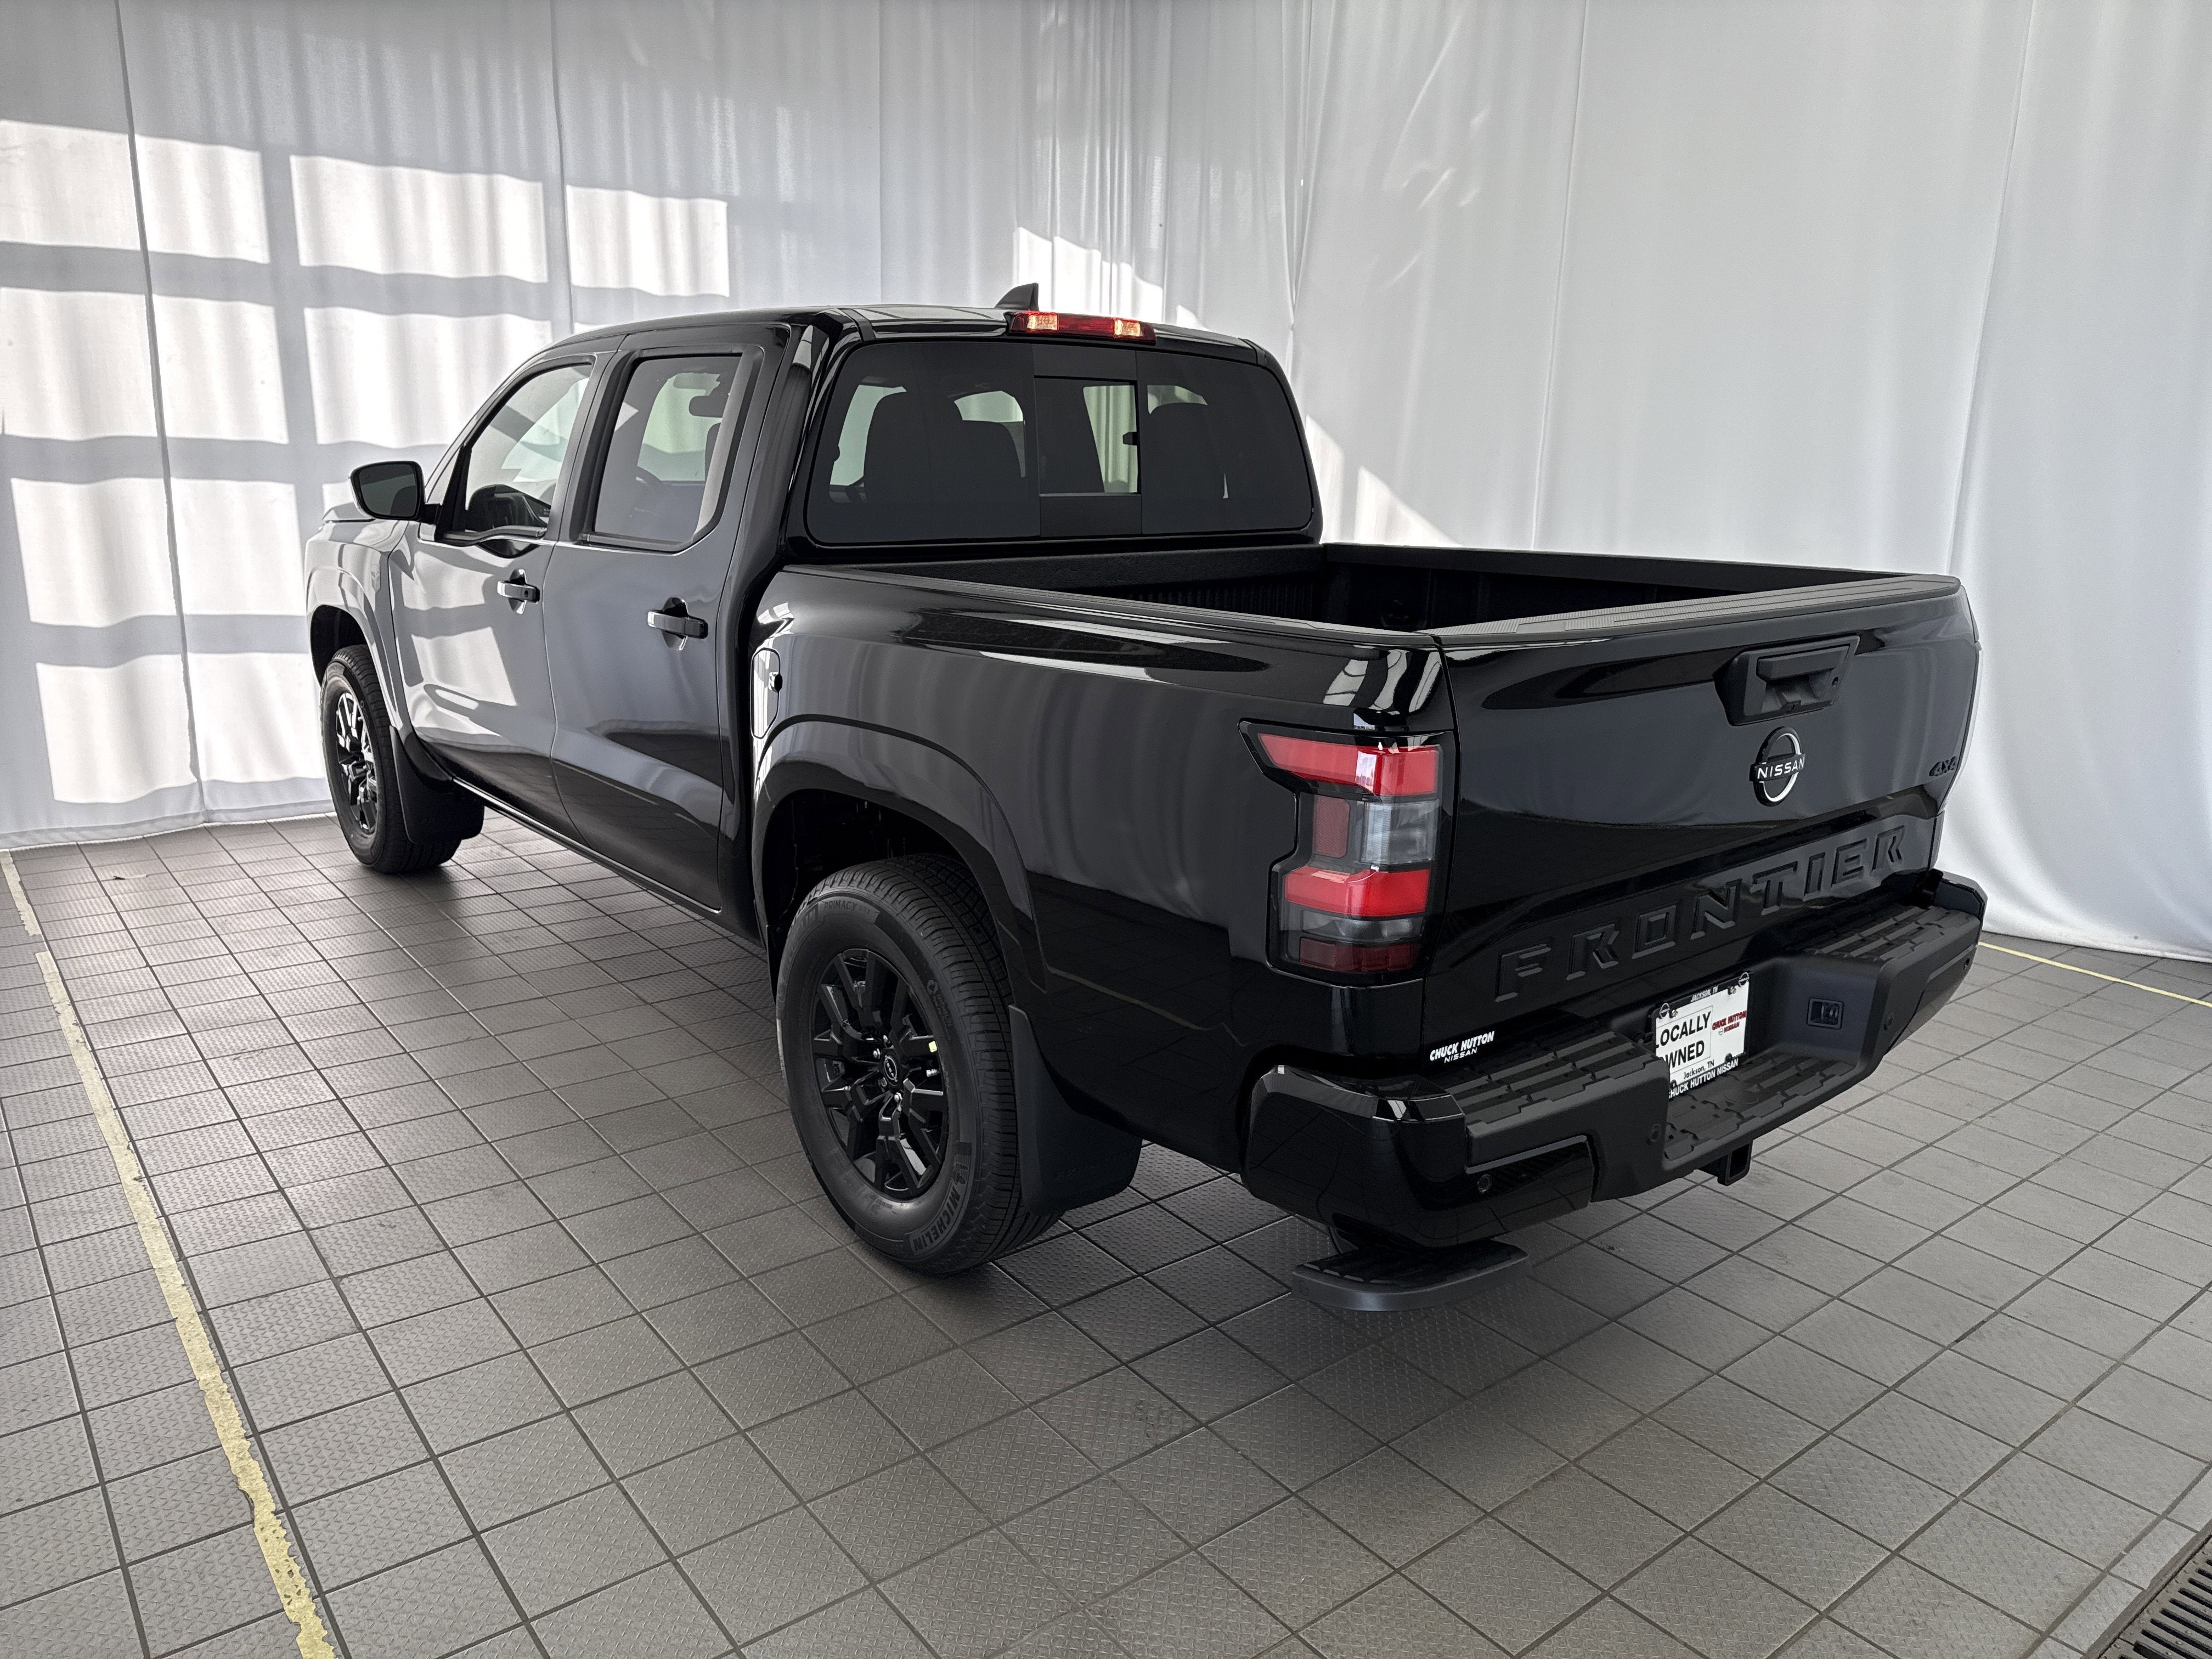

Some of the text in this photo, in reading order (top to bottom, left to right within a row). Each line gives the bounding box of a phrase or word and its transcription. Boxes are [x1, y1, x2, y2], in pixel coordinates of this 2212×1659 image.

[1757, 758, 1805, 780] NISSAN
[824, 900, 857, 911] PRIMACY
[1495, 825, 1905, 1002] FRONTIER
[1656, 1011, 1711, 1048] OCALLY
[1430, 1031, 1494, 1061] CHUCK HUTTON
[1444, 1047, 1477, 1063] NISSAN
[1660, 1040, 1705, 1068] WNED
[1684, 1059, 1714, 1079] Jackson, TN
[1690, 1070, 1716, 1088] HUTTON
[1717, 1059, 1739, 1075] NISSAN
[912, 1186, 961, 1251] MICHELIN
